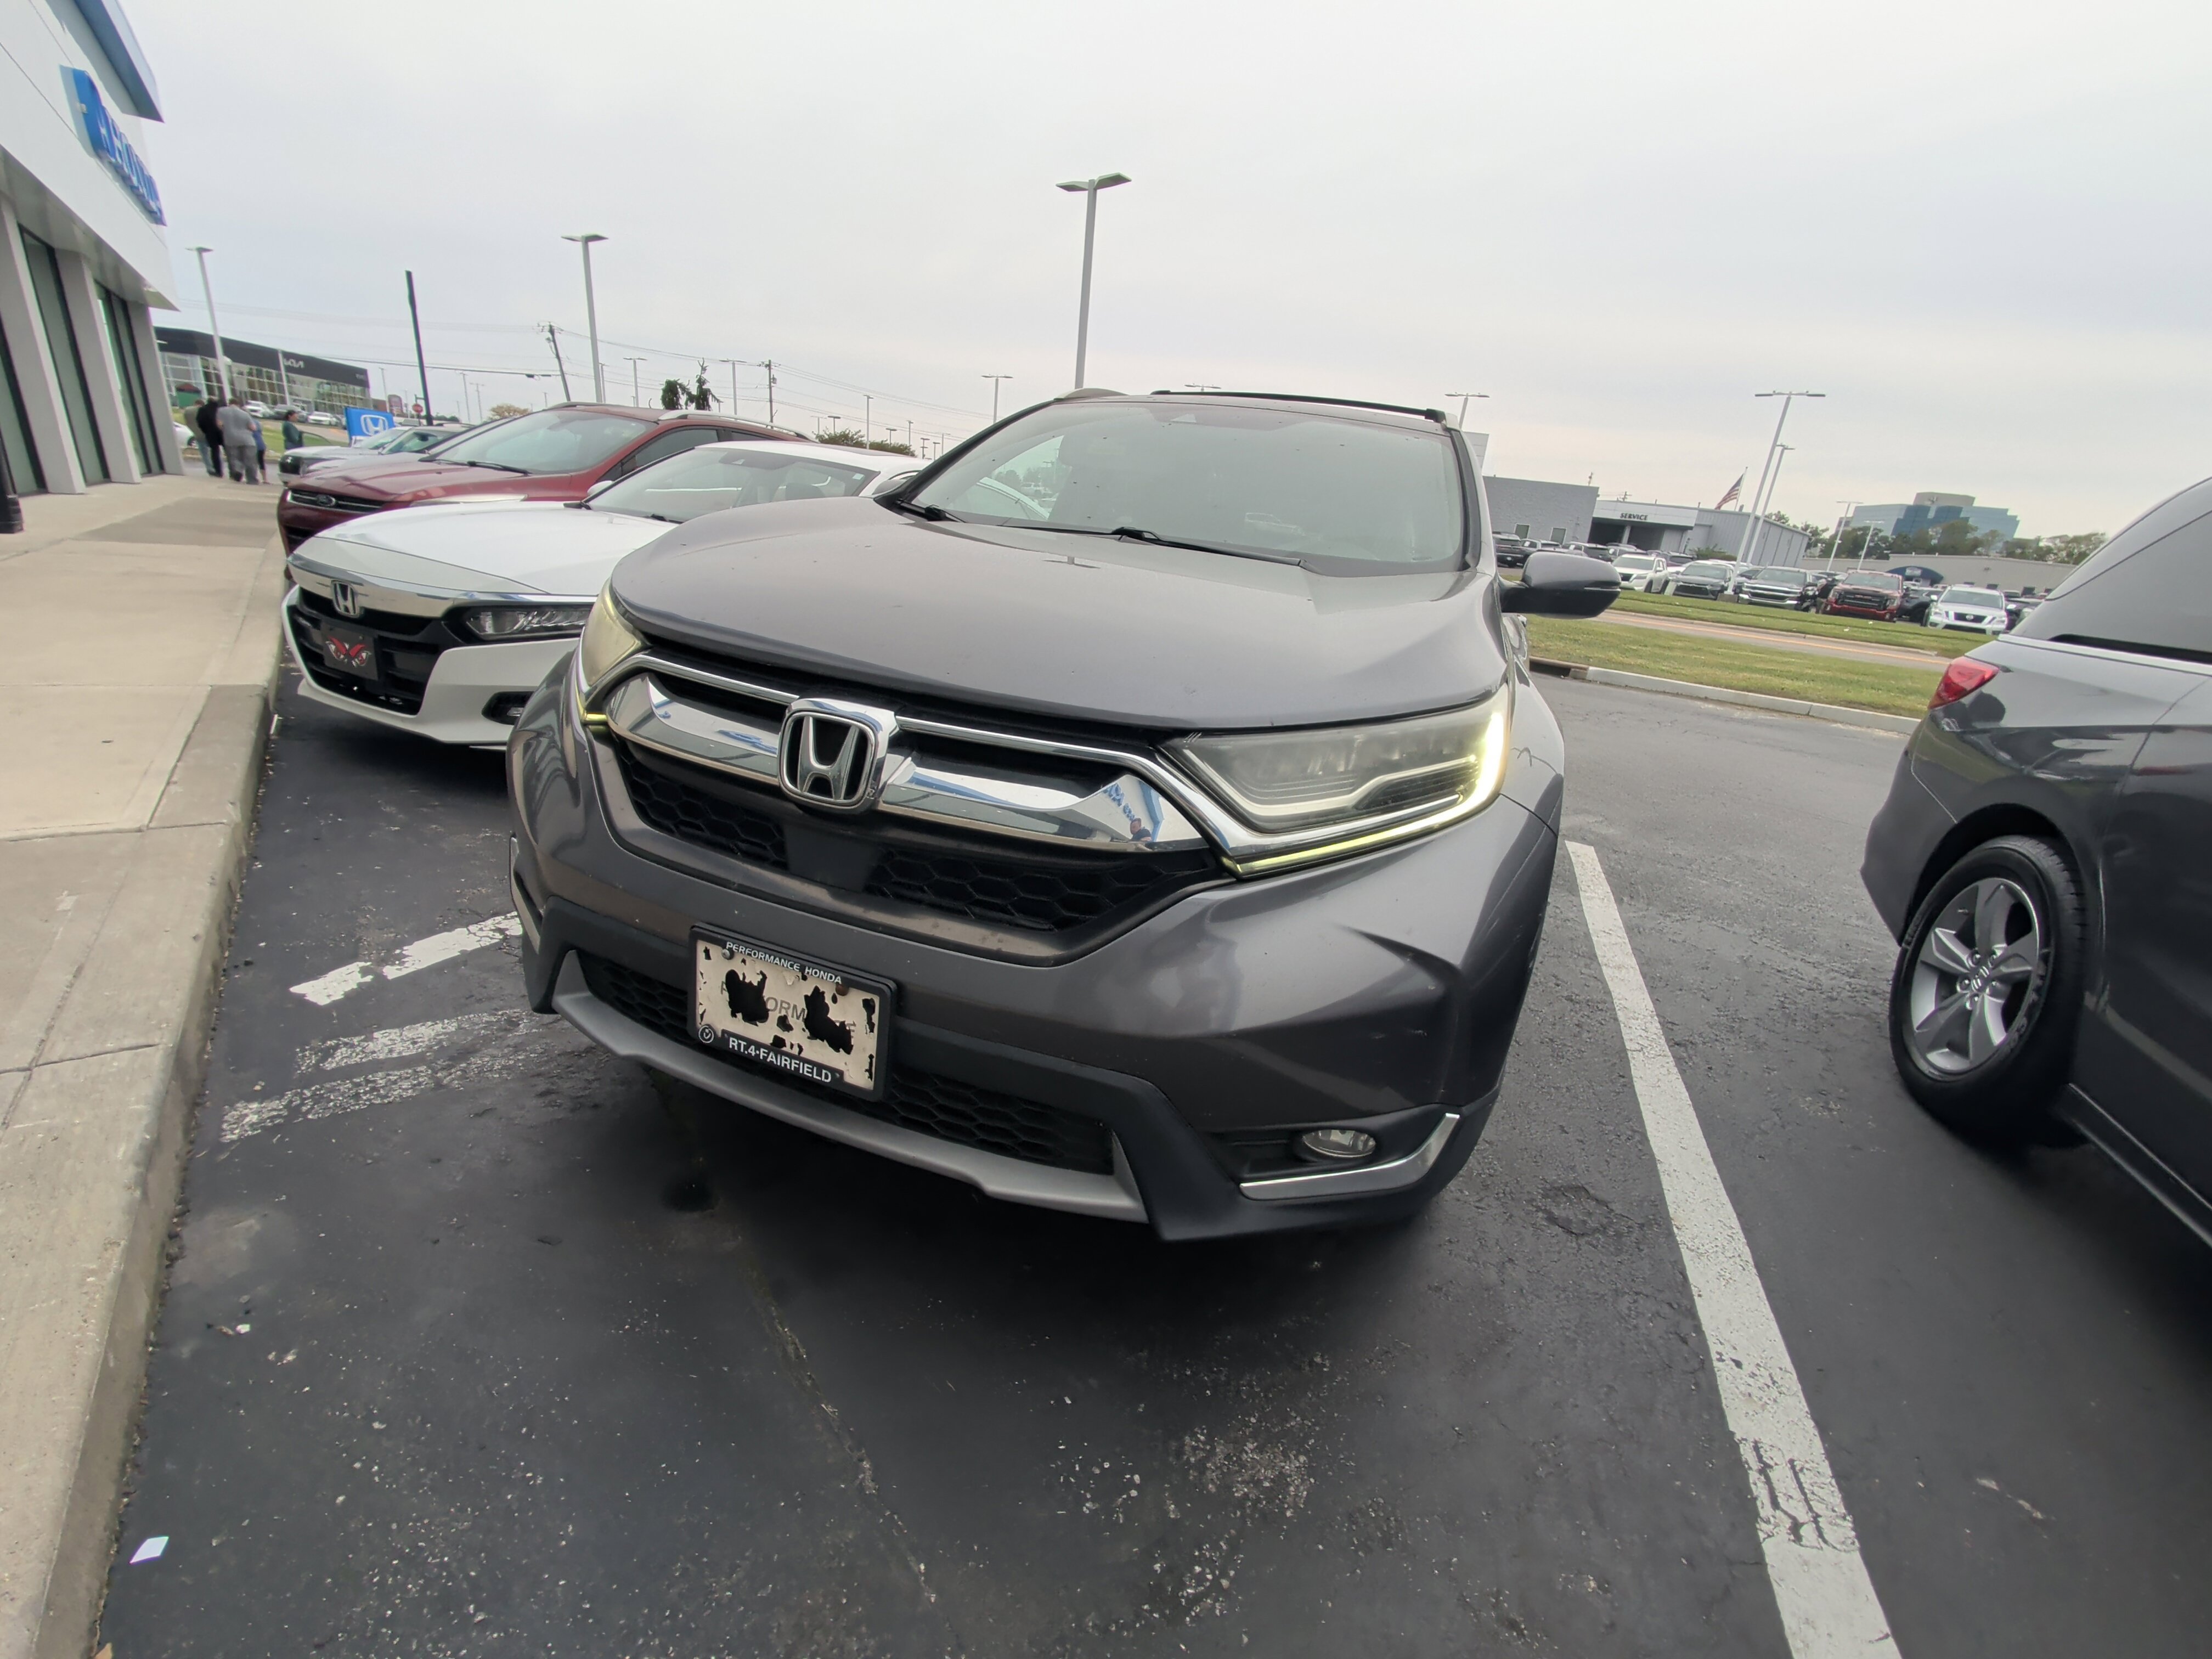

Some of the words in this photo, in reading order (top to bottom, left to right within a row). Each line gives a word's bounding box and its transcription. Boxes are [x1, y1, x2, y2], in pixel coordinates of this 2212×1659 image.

[1620, 512, 1648, 521] SERVICE
[726, 941, 800, 971] PERFORMANCE
[805, 966, 842, 984] HONDA
